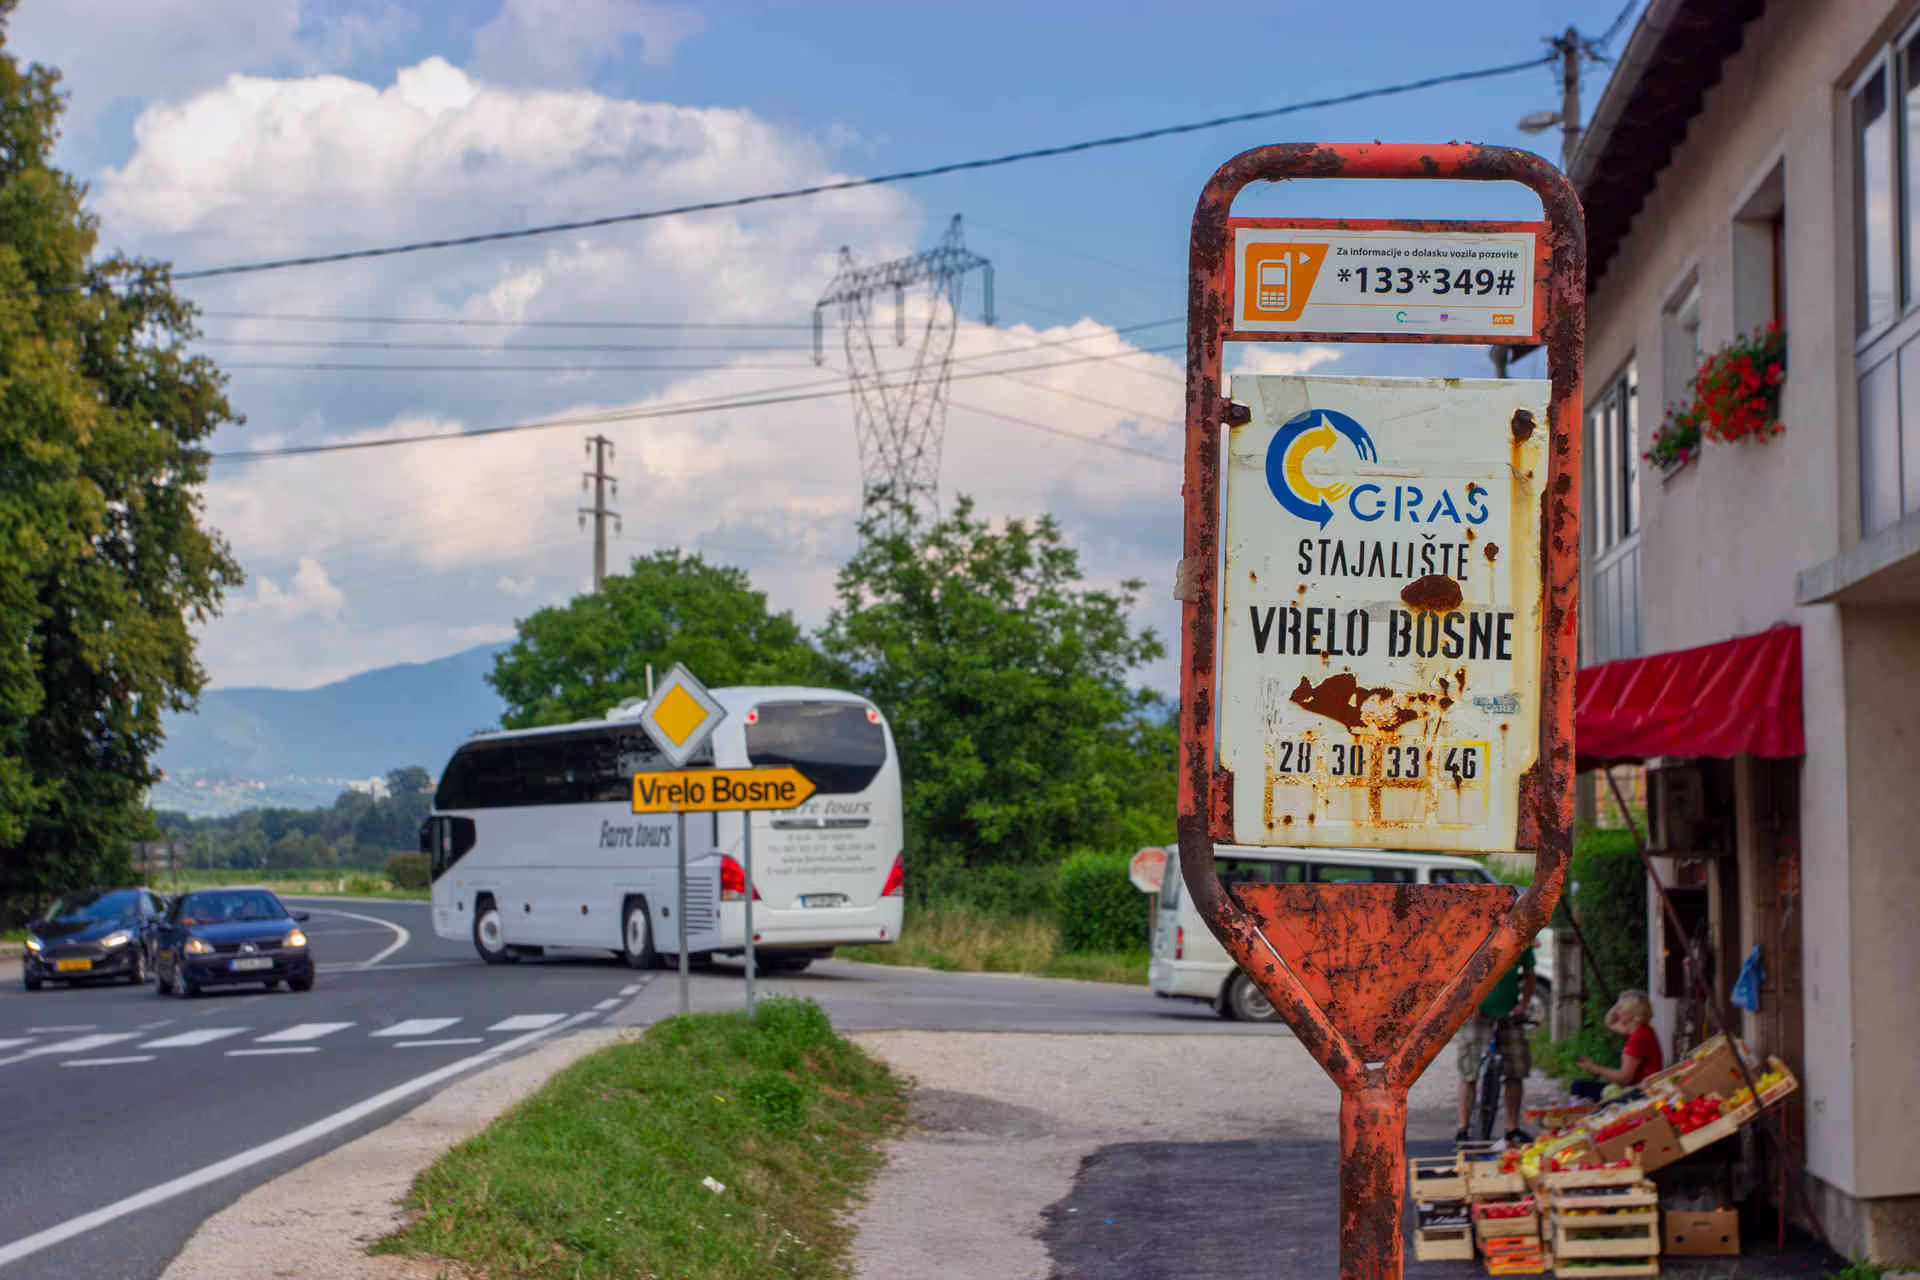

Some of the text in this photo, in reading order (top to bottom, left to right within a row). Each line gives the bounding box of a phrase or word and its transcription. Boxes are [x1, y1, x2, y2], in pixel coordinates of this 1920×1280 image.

[1336, 247, 1348, 256] Za
[1350, 247, 1402, 259] informacije
[1412, 248, 1448, 258] dolasku
[1450, 249, 1477, 258] vozila
[1478, 249, 1520, 260] pozovite
[1349, 482, 1489, 525] GRAS
[1297, 533, 1471, 581] STAJALIŠTE
[1249, 605, 1515, 661] VRELO BOSNE
[1279, 741, 1312, 774] 28
[1331, 743, 1365, 776] 30
[1386, 746, 1420, 779] 33
[638, 775, 797, 805] Vrelo Bosne
